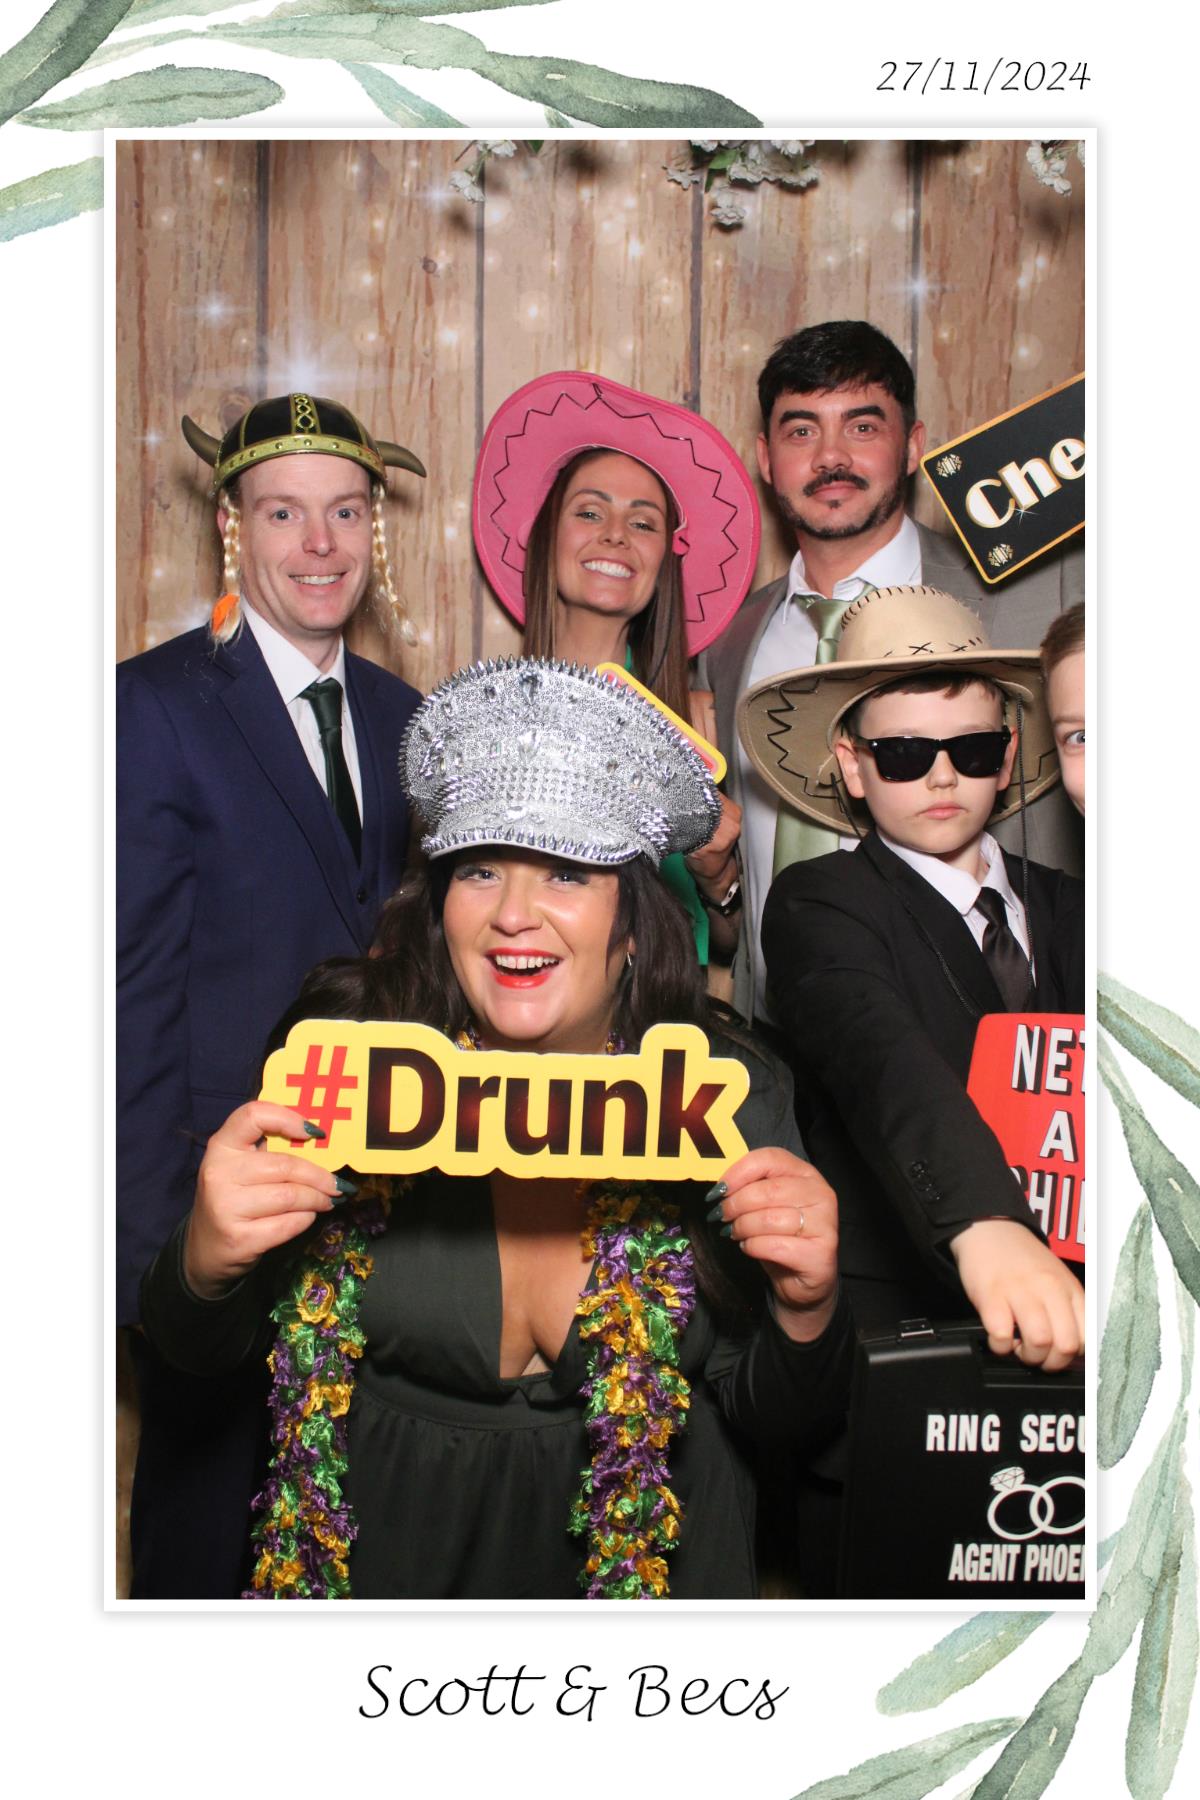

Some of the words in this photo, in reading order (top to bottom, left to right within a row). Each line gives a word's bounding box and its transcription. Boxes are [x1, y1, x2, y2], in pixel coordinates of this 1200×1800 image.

[1011, 1023, 1085, 1095] NE
[284, 1044, 728, 1159] #Drunk
[925, 1414, 1001, 1452] RING
[948, 1543, 1021, 1582] AGENT
